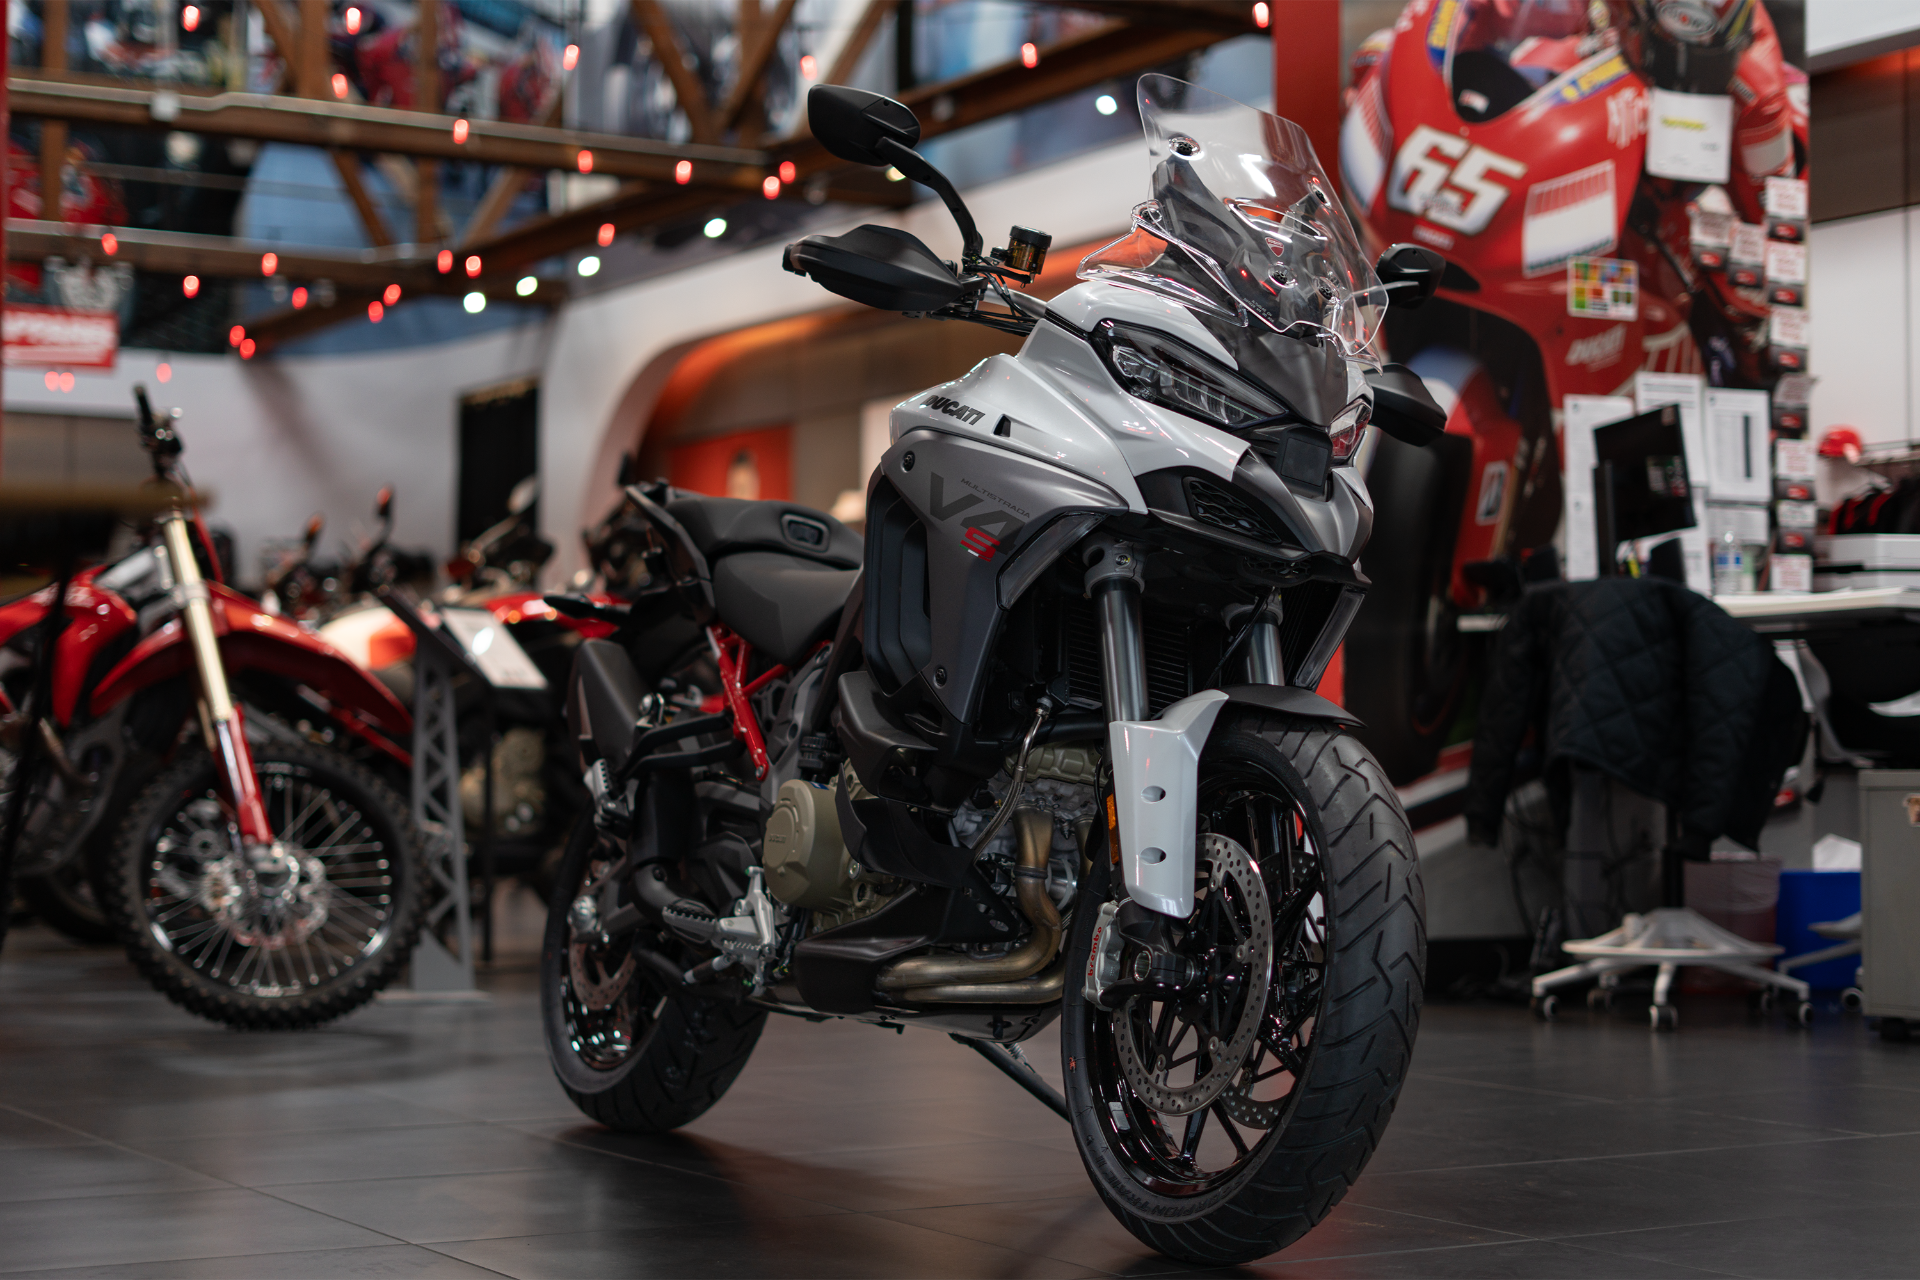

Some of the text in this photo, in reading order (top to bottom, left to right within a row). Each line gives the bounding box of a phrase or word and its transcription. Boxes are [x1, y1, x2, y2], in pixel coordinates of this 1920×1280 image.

[1387, 124, 1528, 236] 65
[921, 394, 986, 426] DUCATI
[930, 472, 1025, 556] V4
[960, 478, 1031, 519] MULTISTRADA
[960, 526, 1001, 558] S
[1088, 927, 1102, 977] brembo
